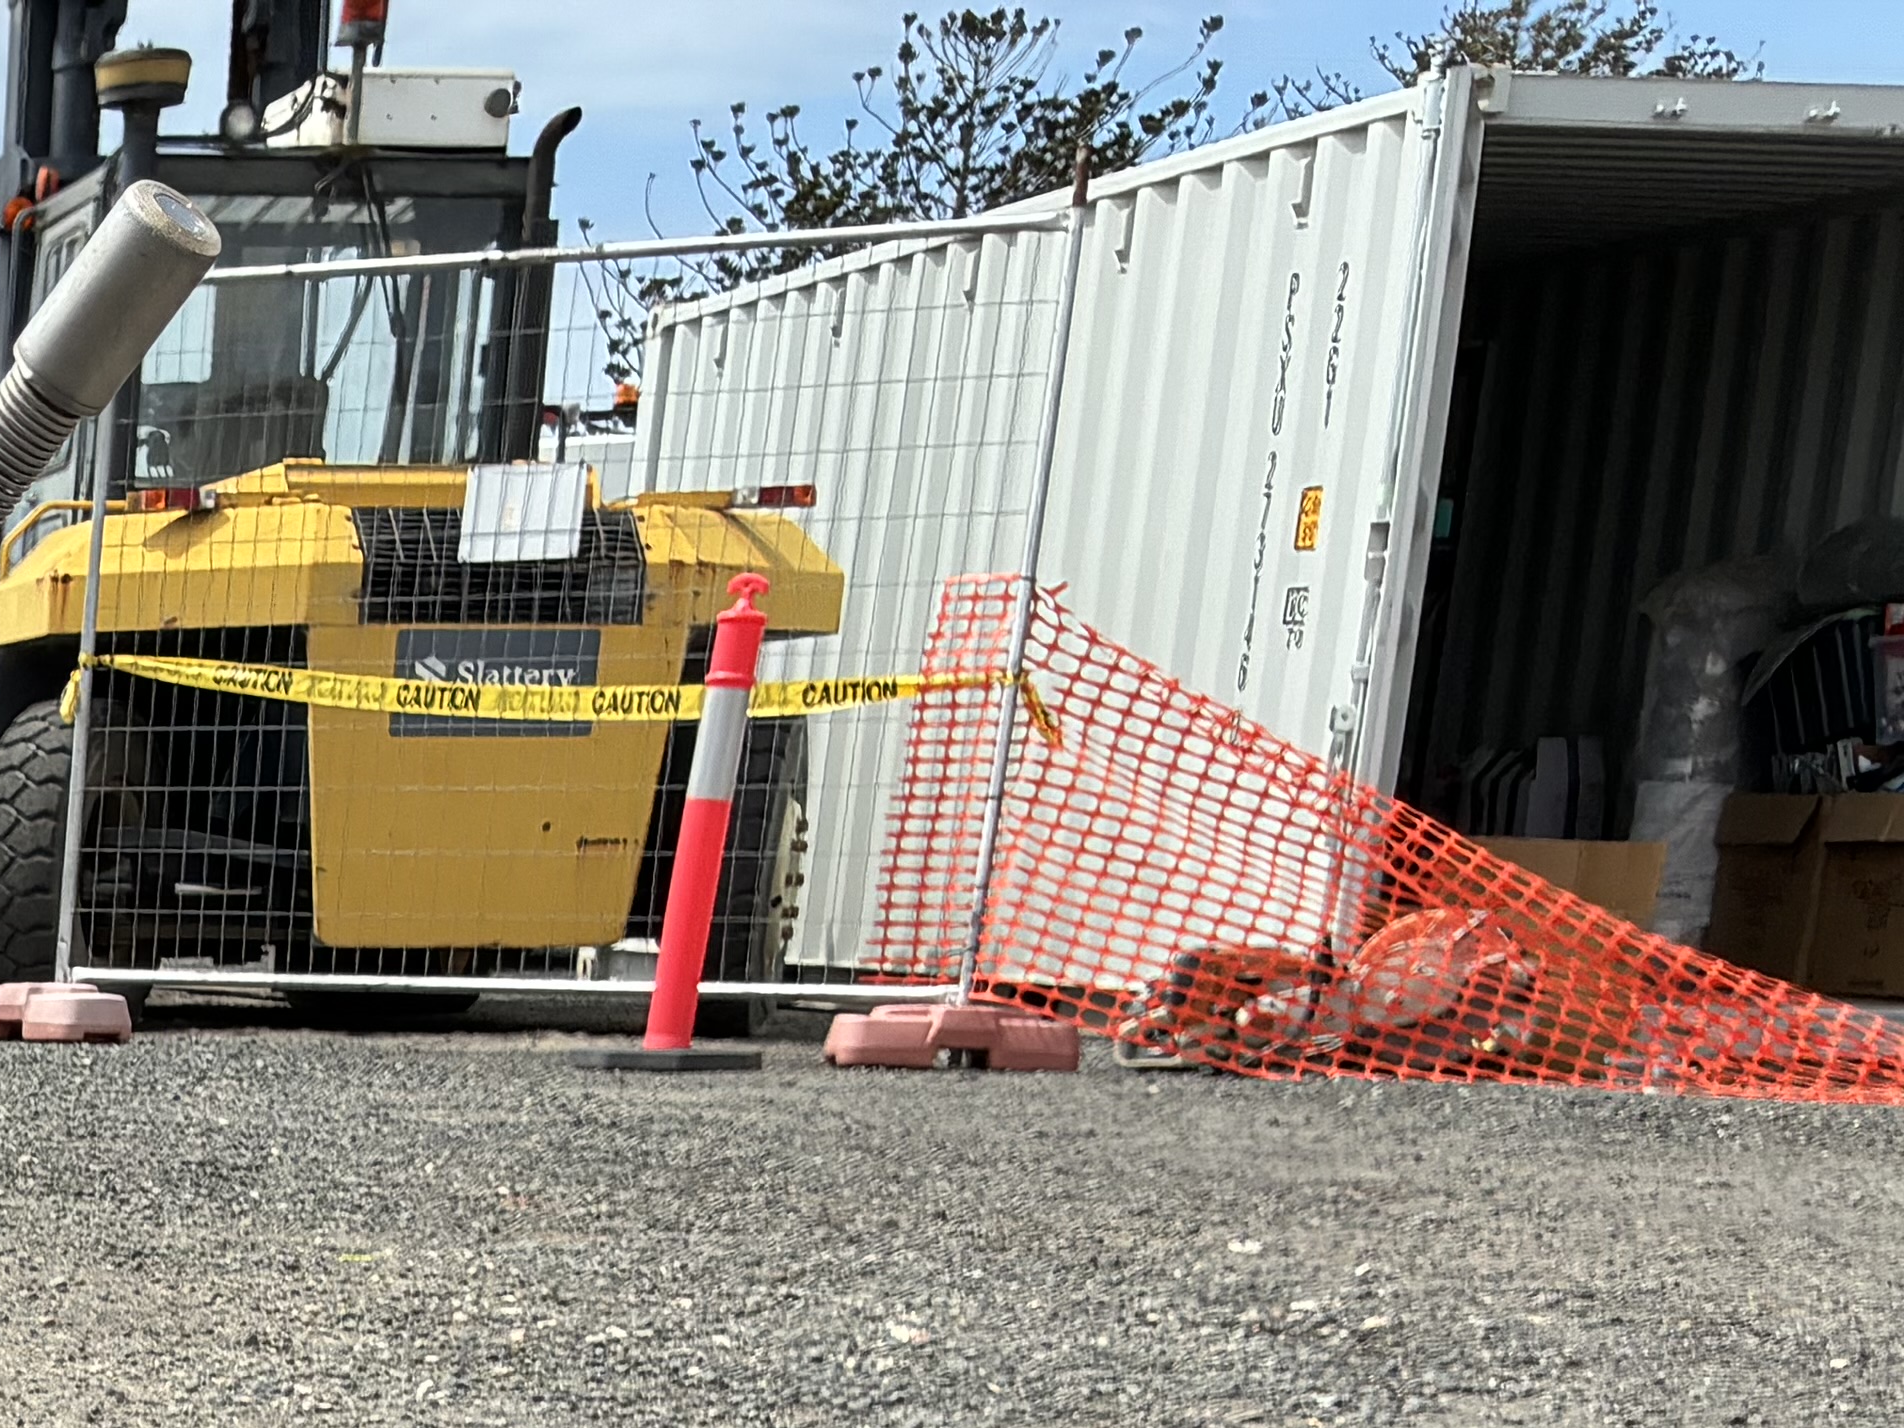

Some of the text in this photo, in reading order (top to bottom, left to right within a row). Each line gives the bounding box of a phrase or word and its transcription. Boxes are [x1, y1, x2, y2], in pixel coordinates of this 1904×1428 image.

[213, 664, 293, 695] CAUTION
[458, 659, 576, 686] Slattery
[396, 683, 481, 713] CAUTION
[592, 687, 681, 715] CAUTION
[802, 679, 898, 708] CAUTION
